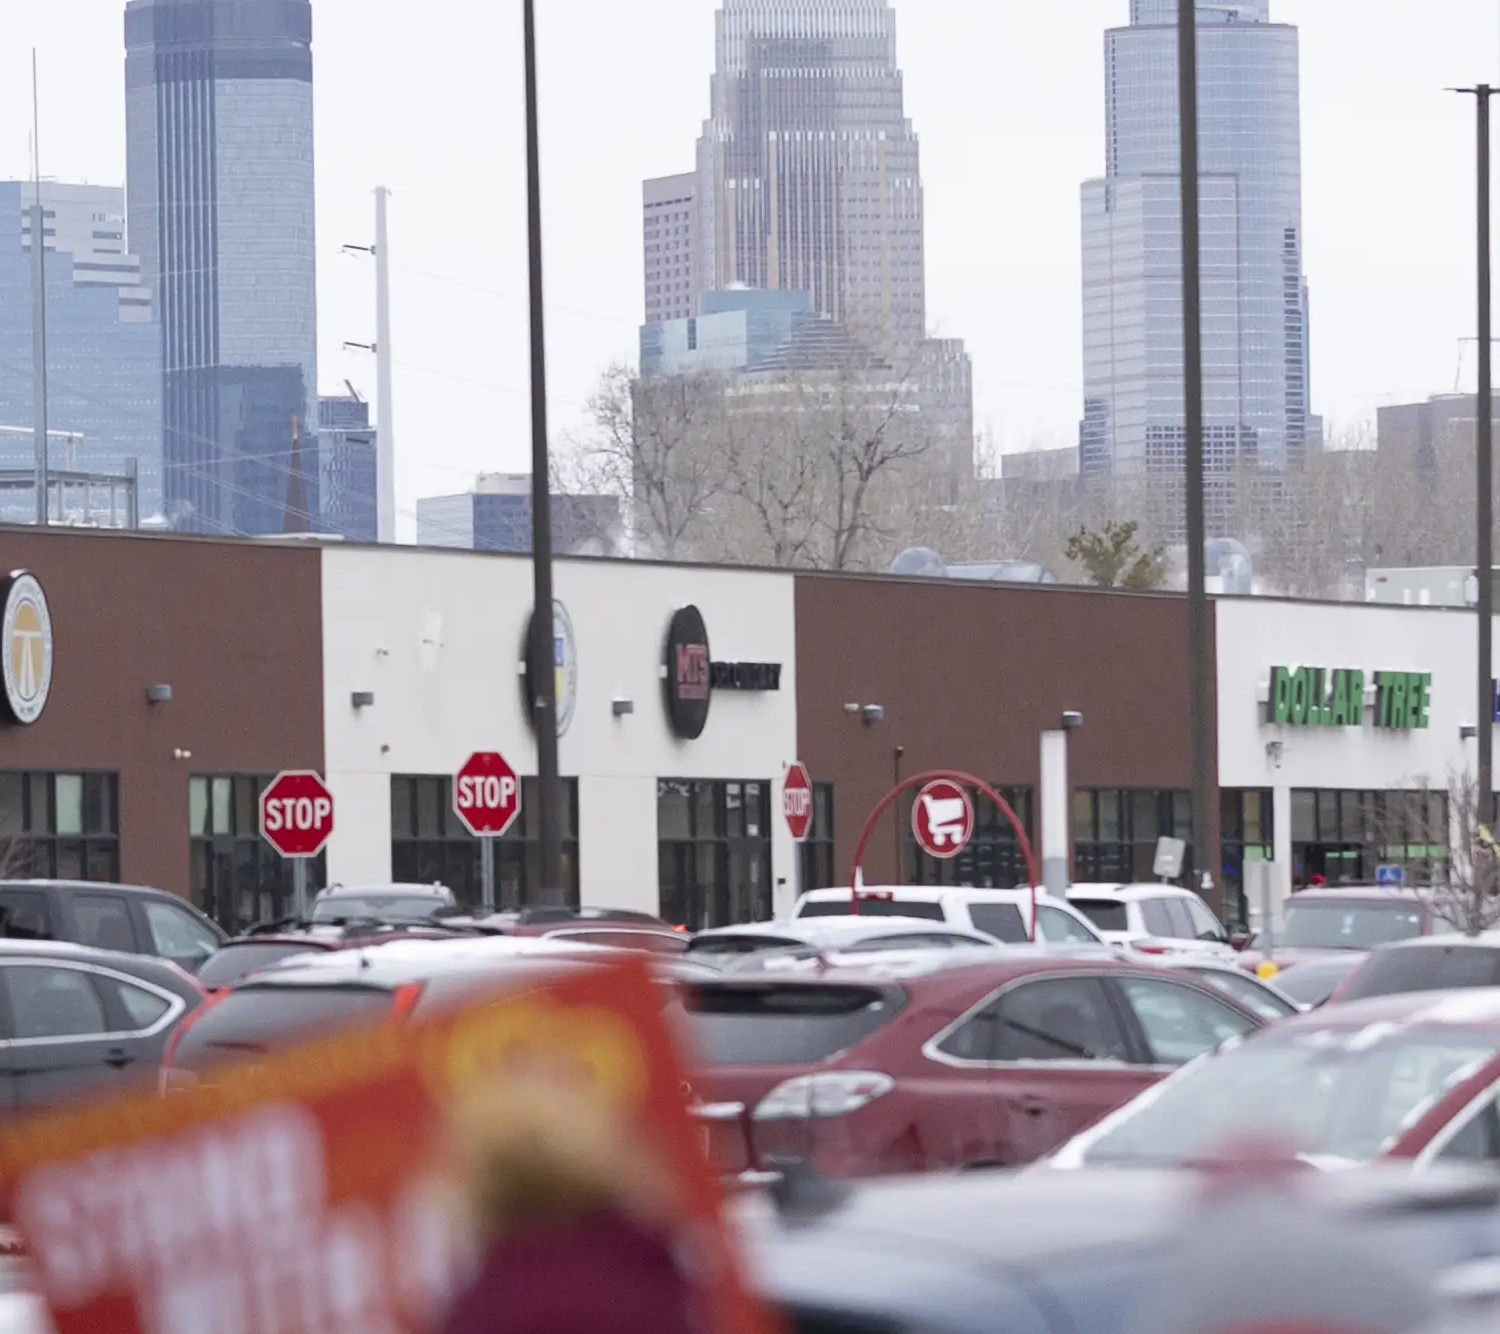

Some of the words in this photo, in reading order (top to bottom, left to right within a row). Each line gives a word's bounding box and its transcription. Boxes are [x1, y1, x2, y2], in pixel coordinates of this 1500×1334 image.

[1268, 666, 1364, 726] DOLLAR
[1373, 671, 1432, 728] TREE
[457, 776, 516, 809] STOP
[782, 788, 811, 816] STOP
[266, 797, 331, 830] STOP
